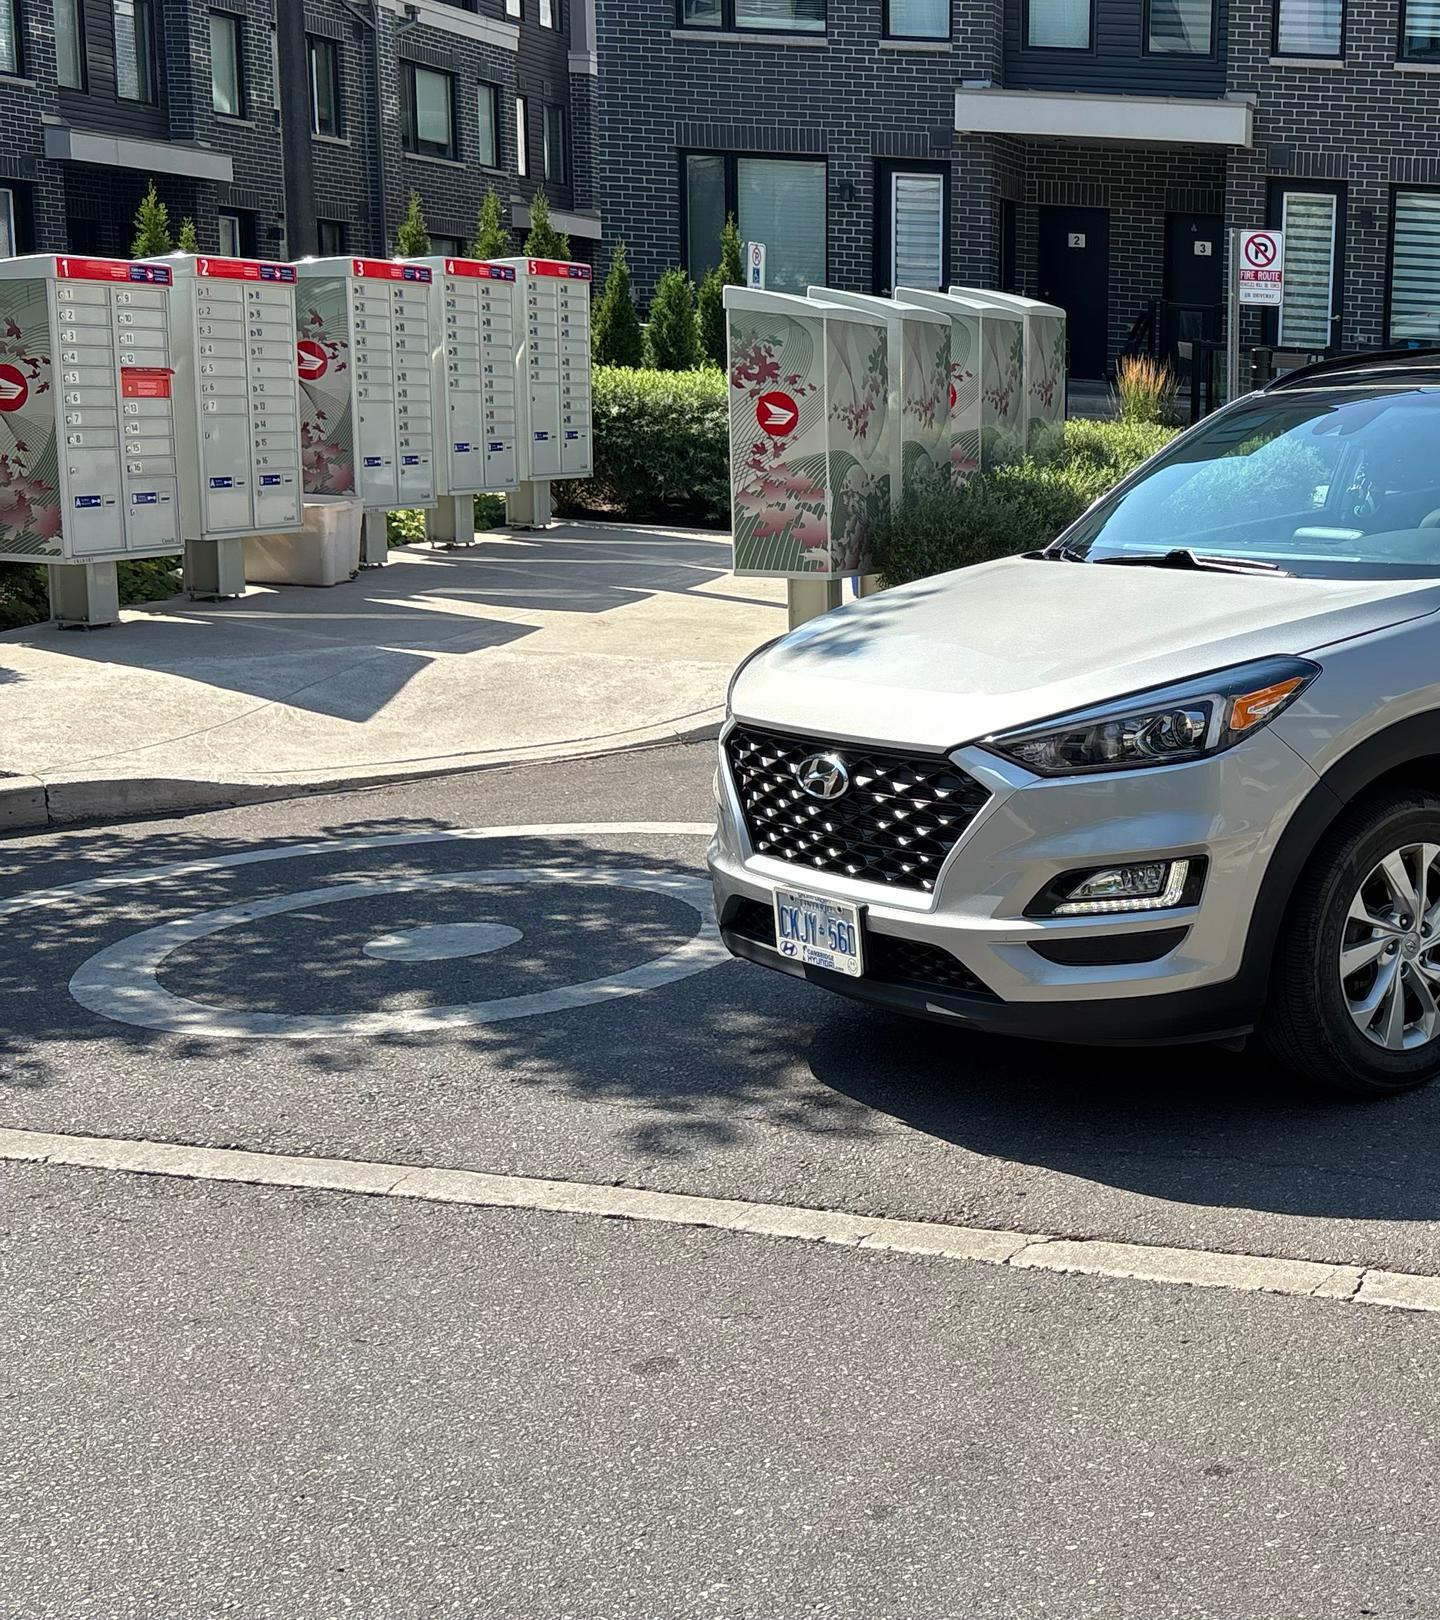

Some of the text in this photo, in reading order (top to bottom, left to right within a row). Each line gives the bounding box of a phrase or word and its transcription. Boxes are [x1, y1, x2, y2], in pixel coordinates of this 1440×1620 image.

[1073, 236, 1080, 245] 2
[1200, 244, 1206, 253] 3
[62, 260, 69, 277] 1
[201, 260, 209, 276] 2
[357, 262, 364, 276] 3
[448, 261, 455, 274] 4
[531, 262, 537, 275] 5
[1241, 270, 1281, 282] FIRE ROUTE
[67, 289, 71, 298] 1
[124, 294, 130, 303] 9
[68, 311, 73, 319] 2
[125, 315, 132, 323] 10
[69, 331, 74, 340] 3
[126, 334, 133, 342] 11
[70, 353, 76, 361] 4
[127, 354, 134, 363] 12
[72, 373, 77, 381] 5
[73, 394, 78, 402] 6
[130, 404, 137, 413] 13
[74, 415, 80, 423] 7
[131, 424, 138, 432] 14
[76, 435, 81, 444] 8
[133, 444, 140, 452] 15
[134, 463, 141, 472] 16
[76, 498, 81, 507] A
[780, 905, 857, 957] CKJY 560
